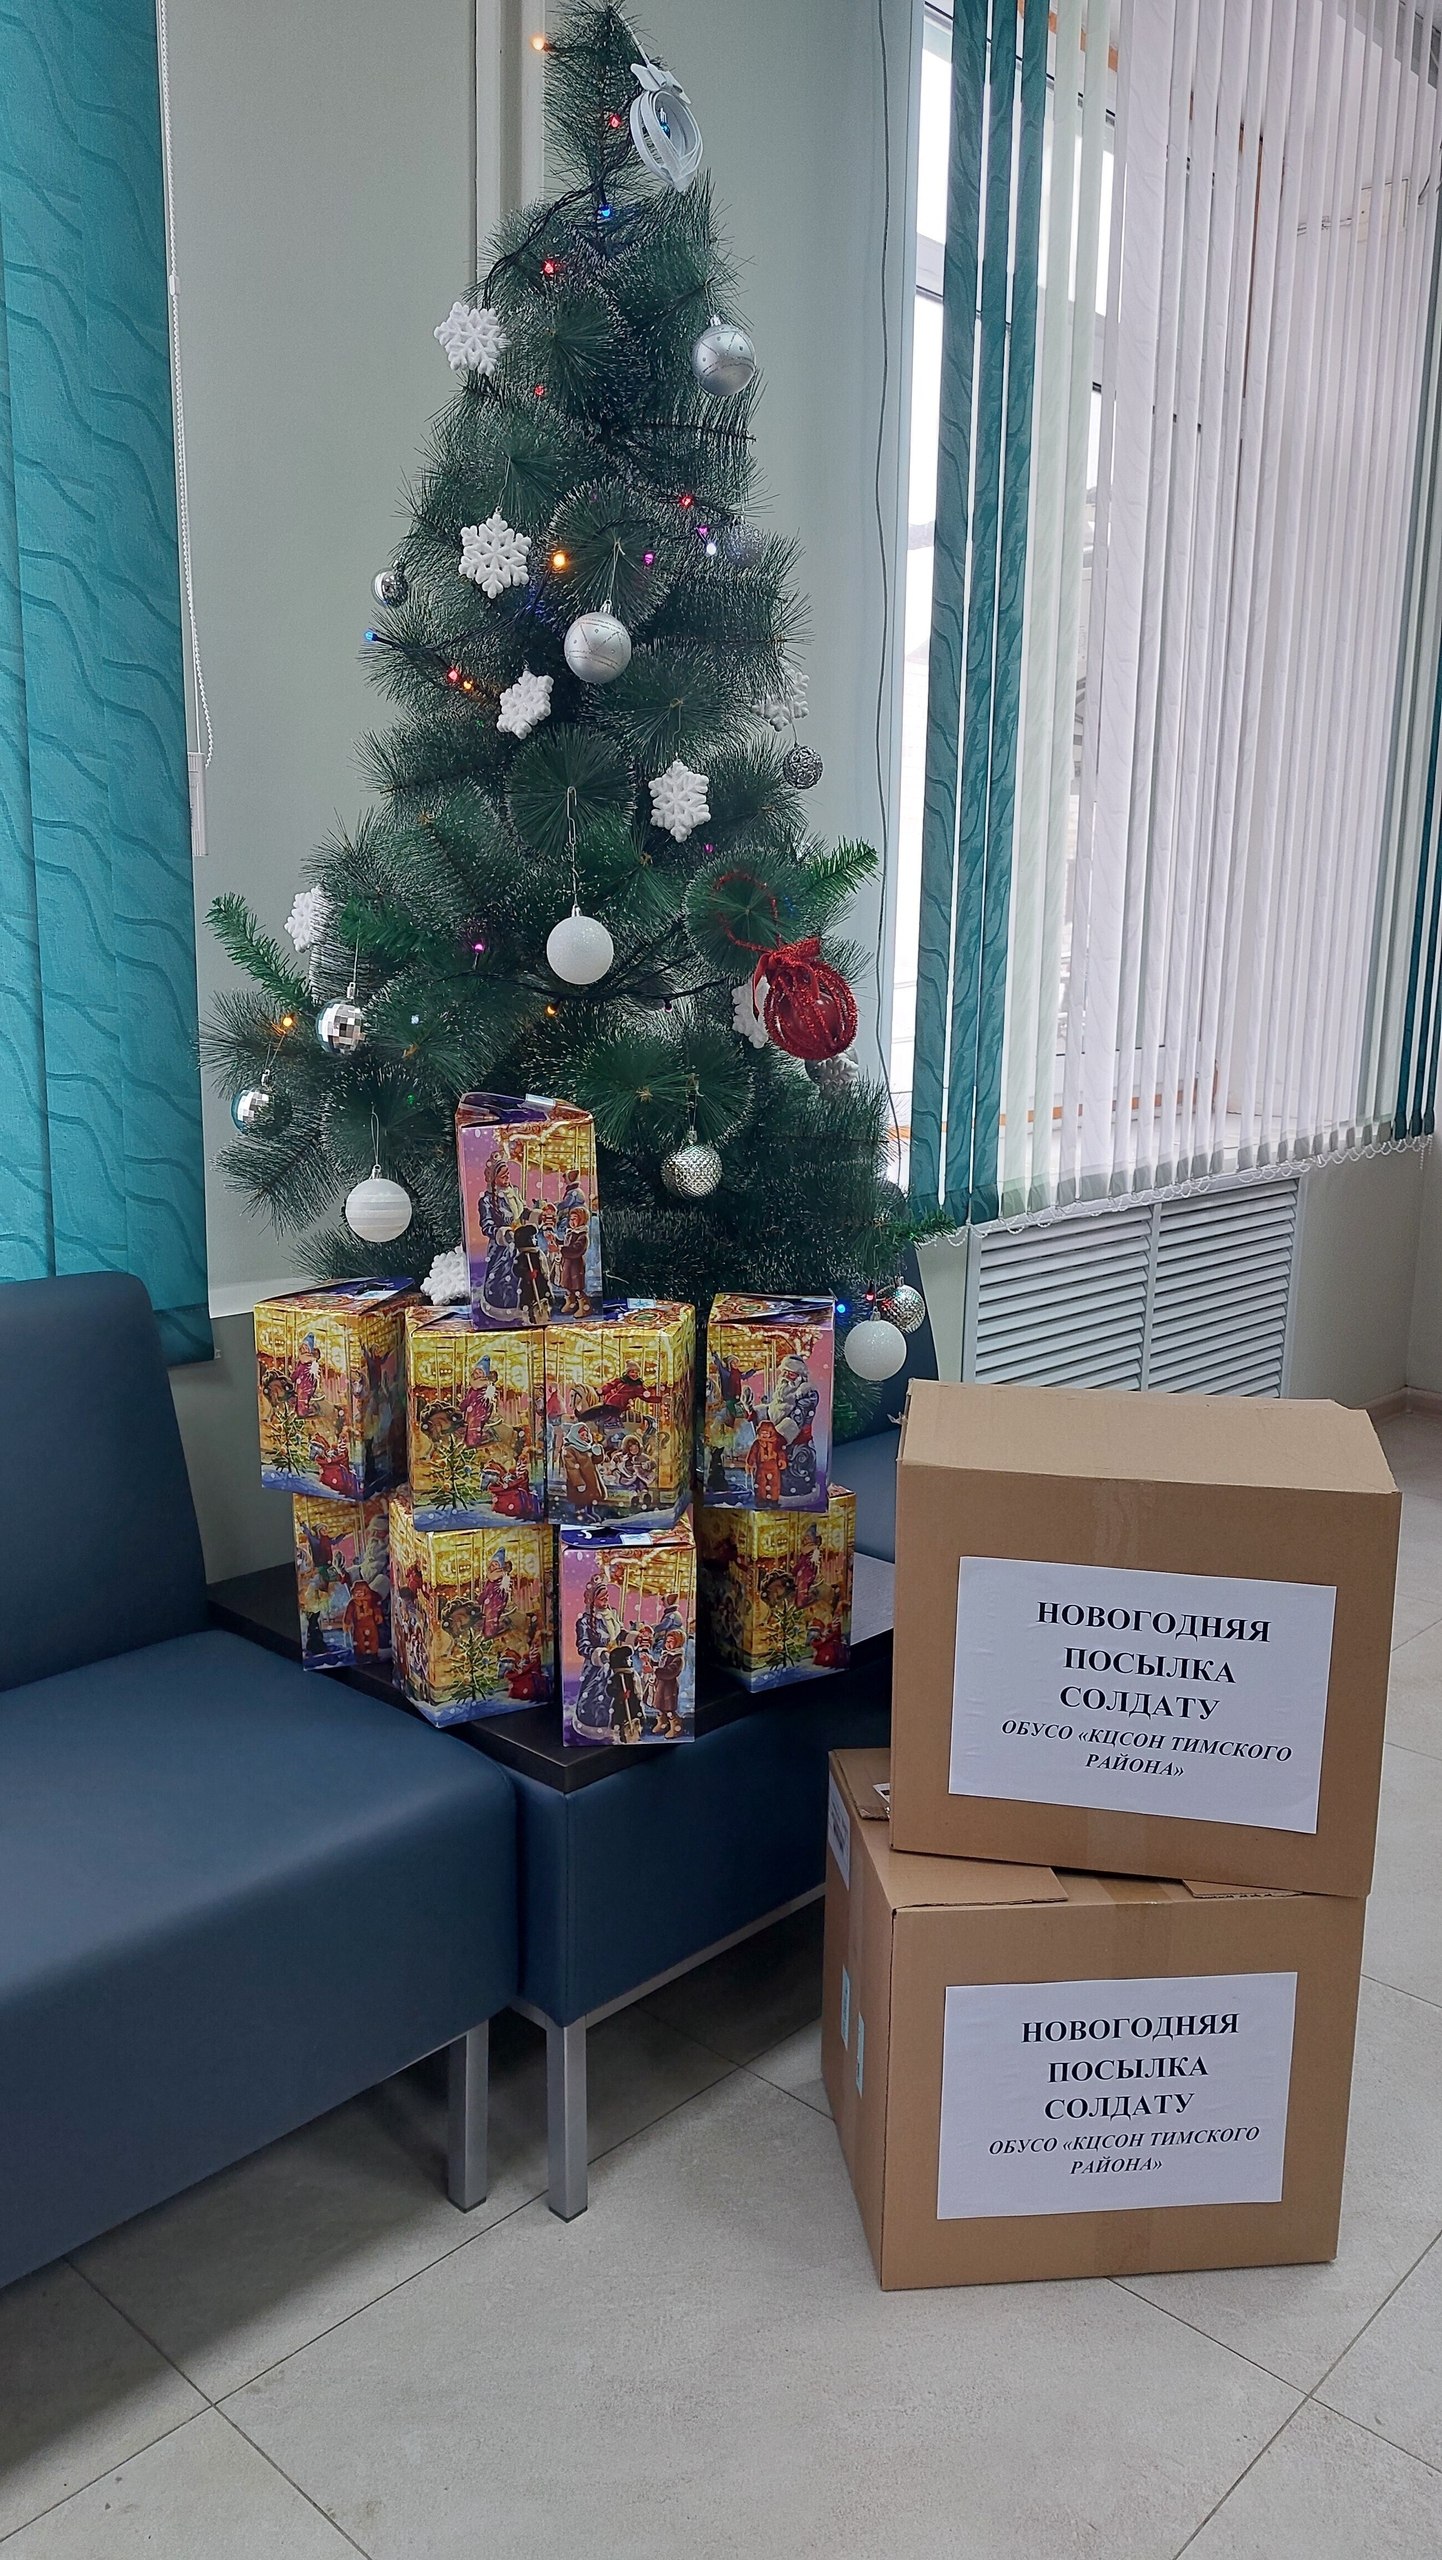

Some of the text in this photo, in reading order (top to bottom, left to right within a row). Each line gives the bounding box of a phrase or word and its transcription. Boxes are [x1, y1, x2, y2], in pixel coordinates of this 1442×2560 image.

[1036, 1602, 1271, 1642] НОВОГОДНЯЯ
[1064, 1647, 1236, 1683] ПОСЫЛКА
[1060, 1687, 1220, 1720] СОЛДАТУ
[1002, 1720, 1291, 1761] ОБУСО «КЦСОН ТИМСКОГО
[1085, 1754, 1183, 1776] РАЙОНА»
[1021, 2013, 1240, 2043] НОВОГОДНЯЯ
[1048, 2056, 1208, 2083] ПОСЫЛКА
[1045, 2093, 1195, 2121] СОЛДАТУ
[990, 2127, 1259, 2154] ОБУСО «КЦСОН ТИМСКОГО
[1070, 2157, 1162, 2174] РАЙОНА»
